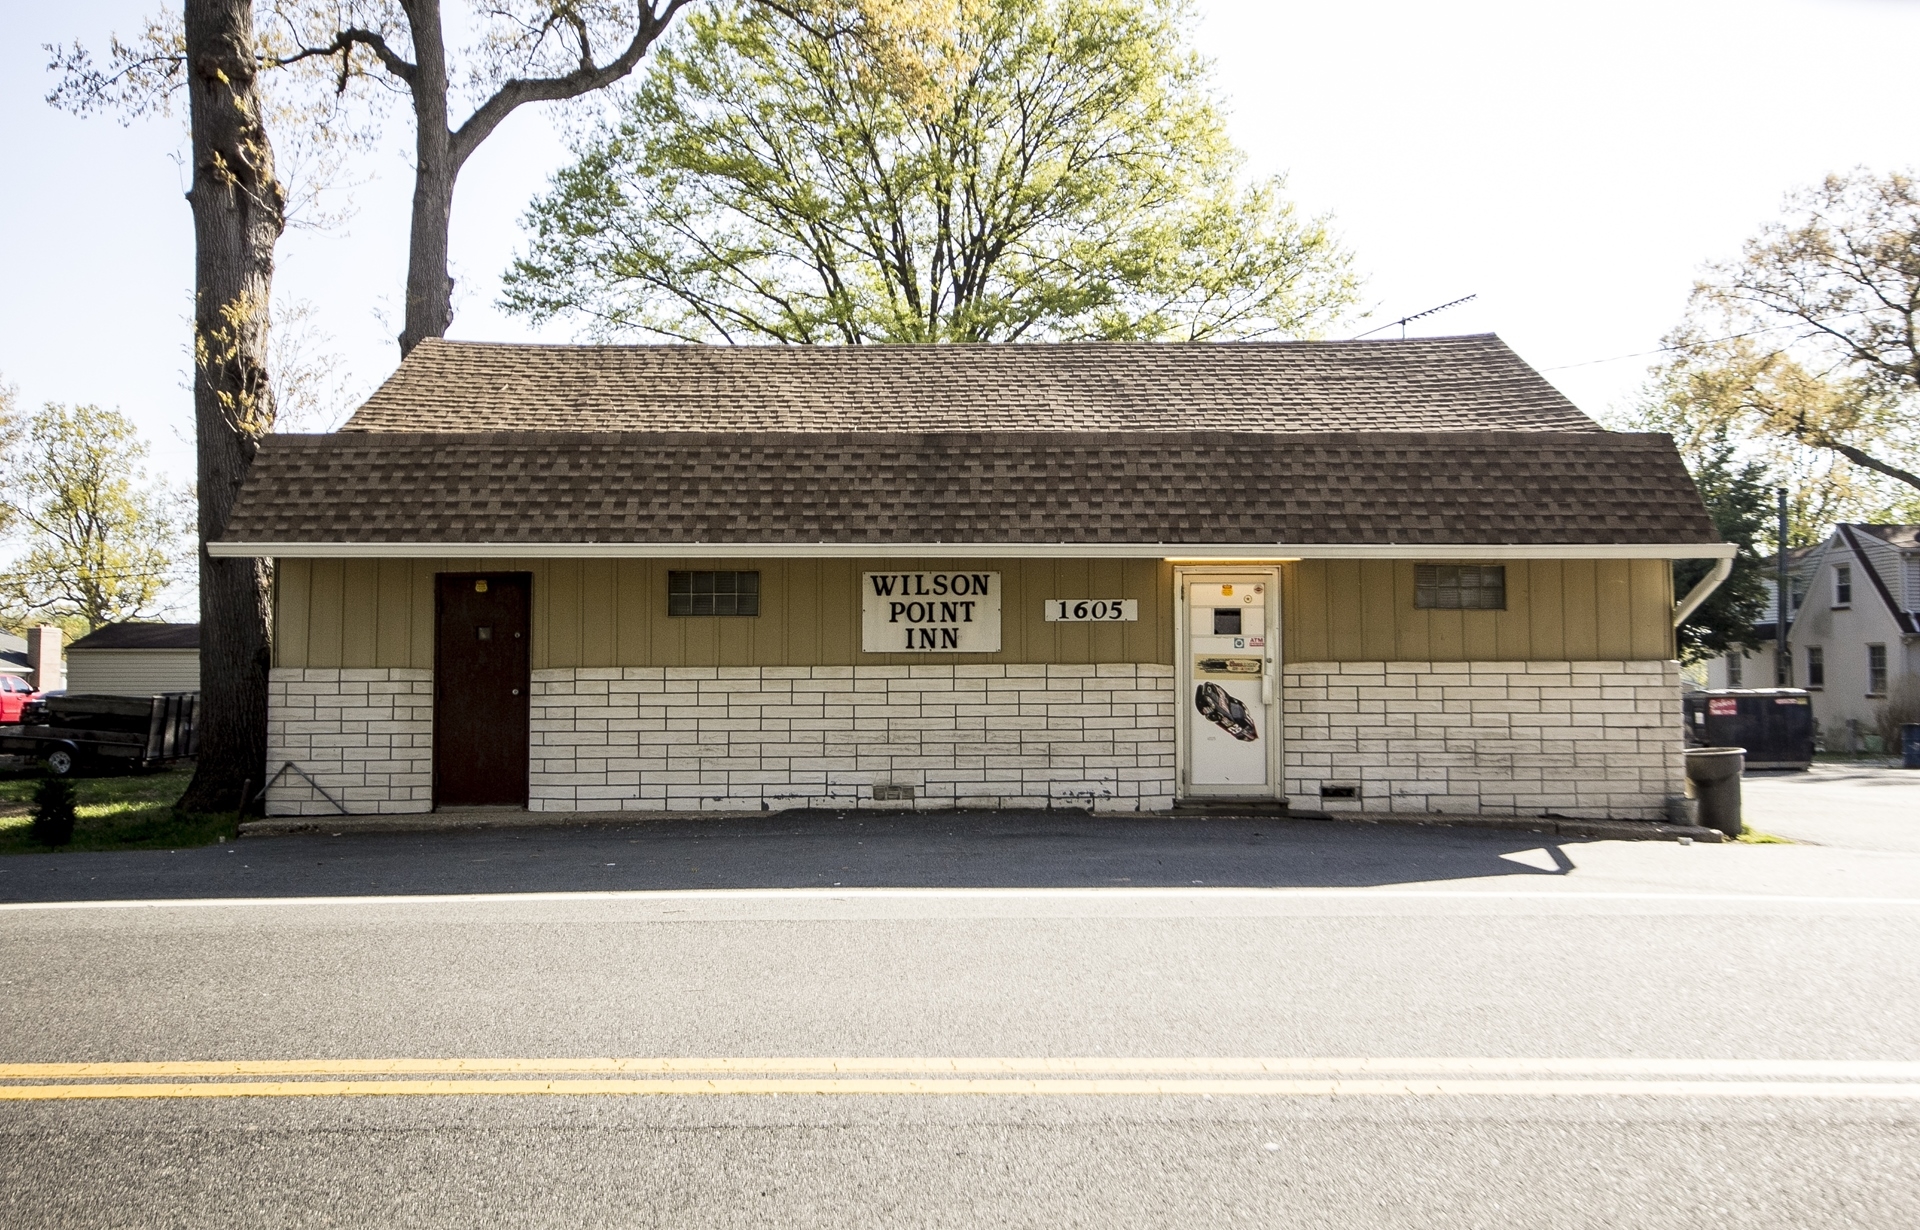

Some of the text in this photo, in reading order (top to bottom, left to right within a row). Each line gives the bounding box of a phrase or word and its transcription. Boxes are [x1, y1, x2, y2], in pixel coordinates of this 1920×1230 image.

[870, 574, 990, 596] WILSON
[889, 601, 976, 623] POINT
[1058, 600, 1123, 620] 1605
[905, 628, 959, 649] INN
